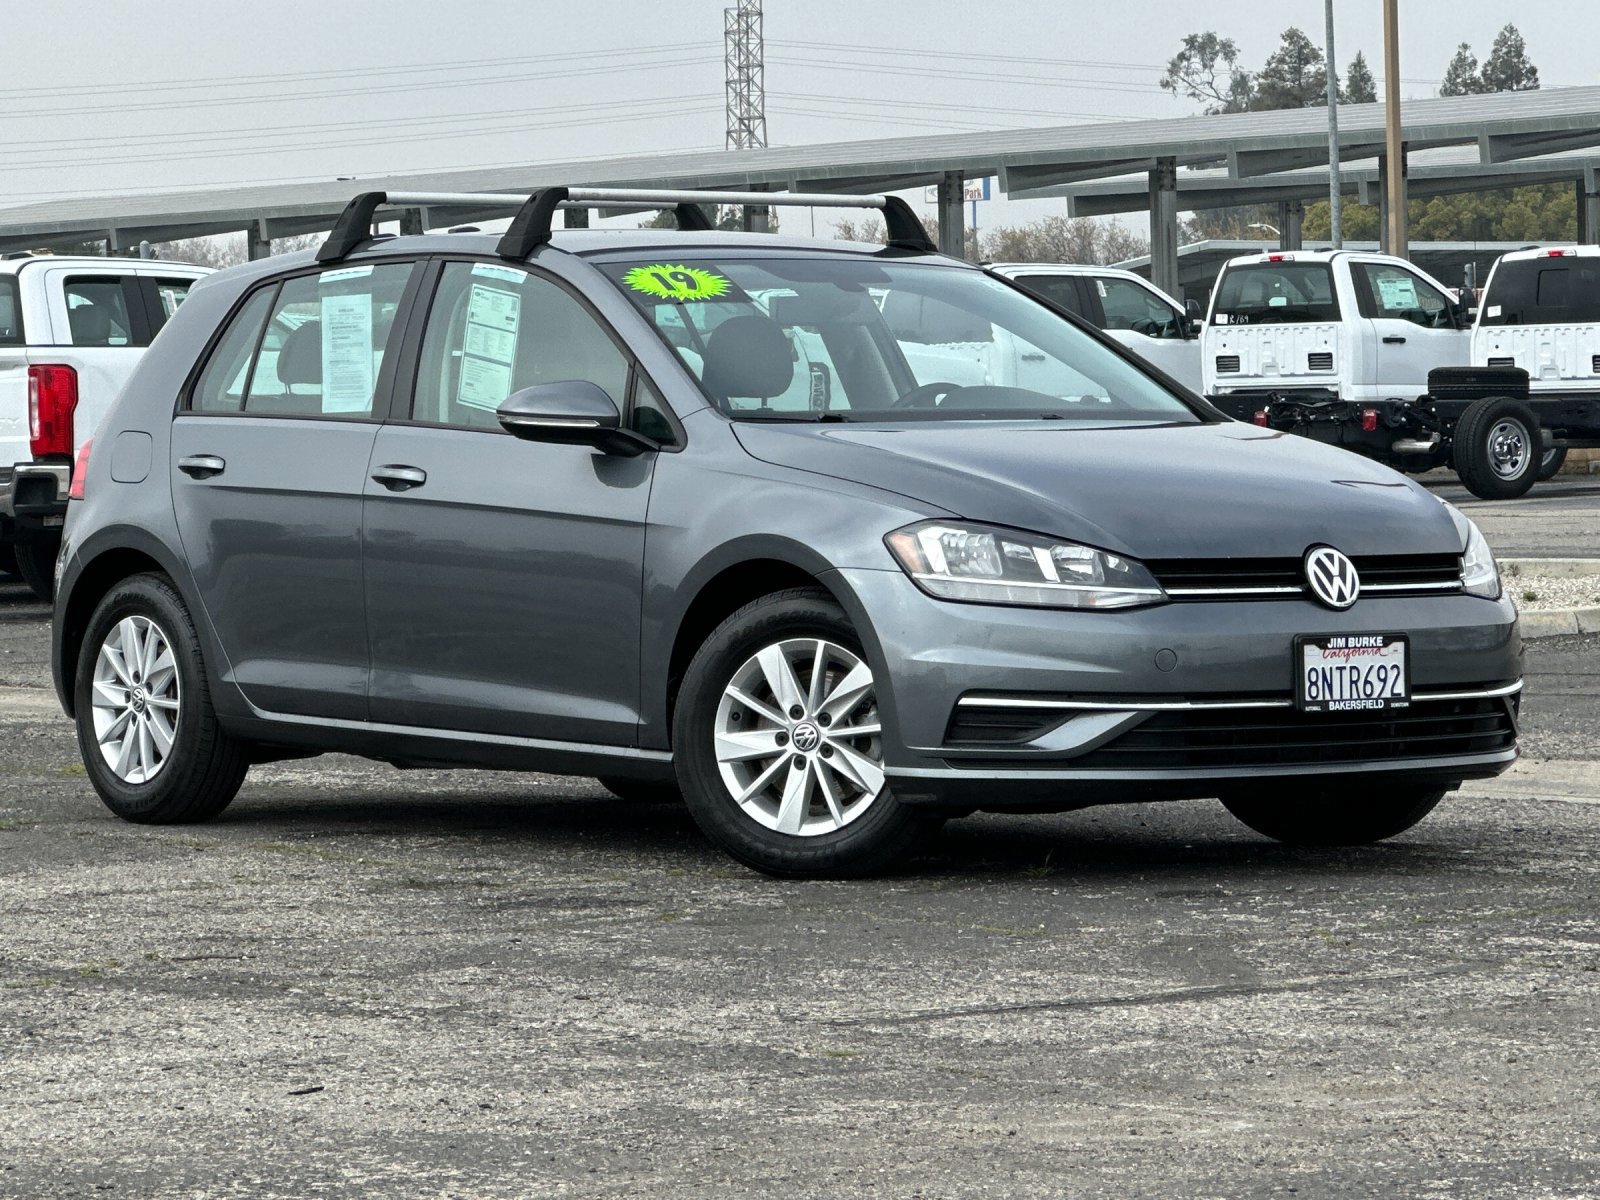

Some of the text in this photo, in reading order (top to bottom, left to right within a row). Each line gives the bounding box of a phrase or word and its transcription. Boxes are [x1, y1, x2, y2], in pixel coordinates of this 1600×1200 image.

[964, 188, 982, 200] Park
[650, 271, 698, 291] 19
[1327, 636, 1383, 648] JIM BURKE
[1322, 647, 1388, 662] California
[1307, 664, 1402, 700] 8NTR692
[1329, 700, 1384, 711] BAKERSFIELD
